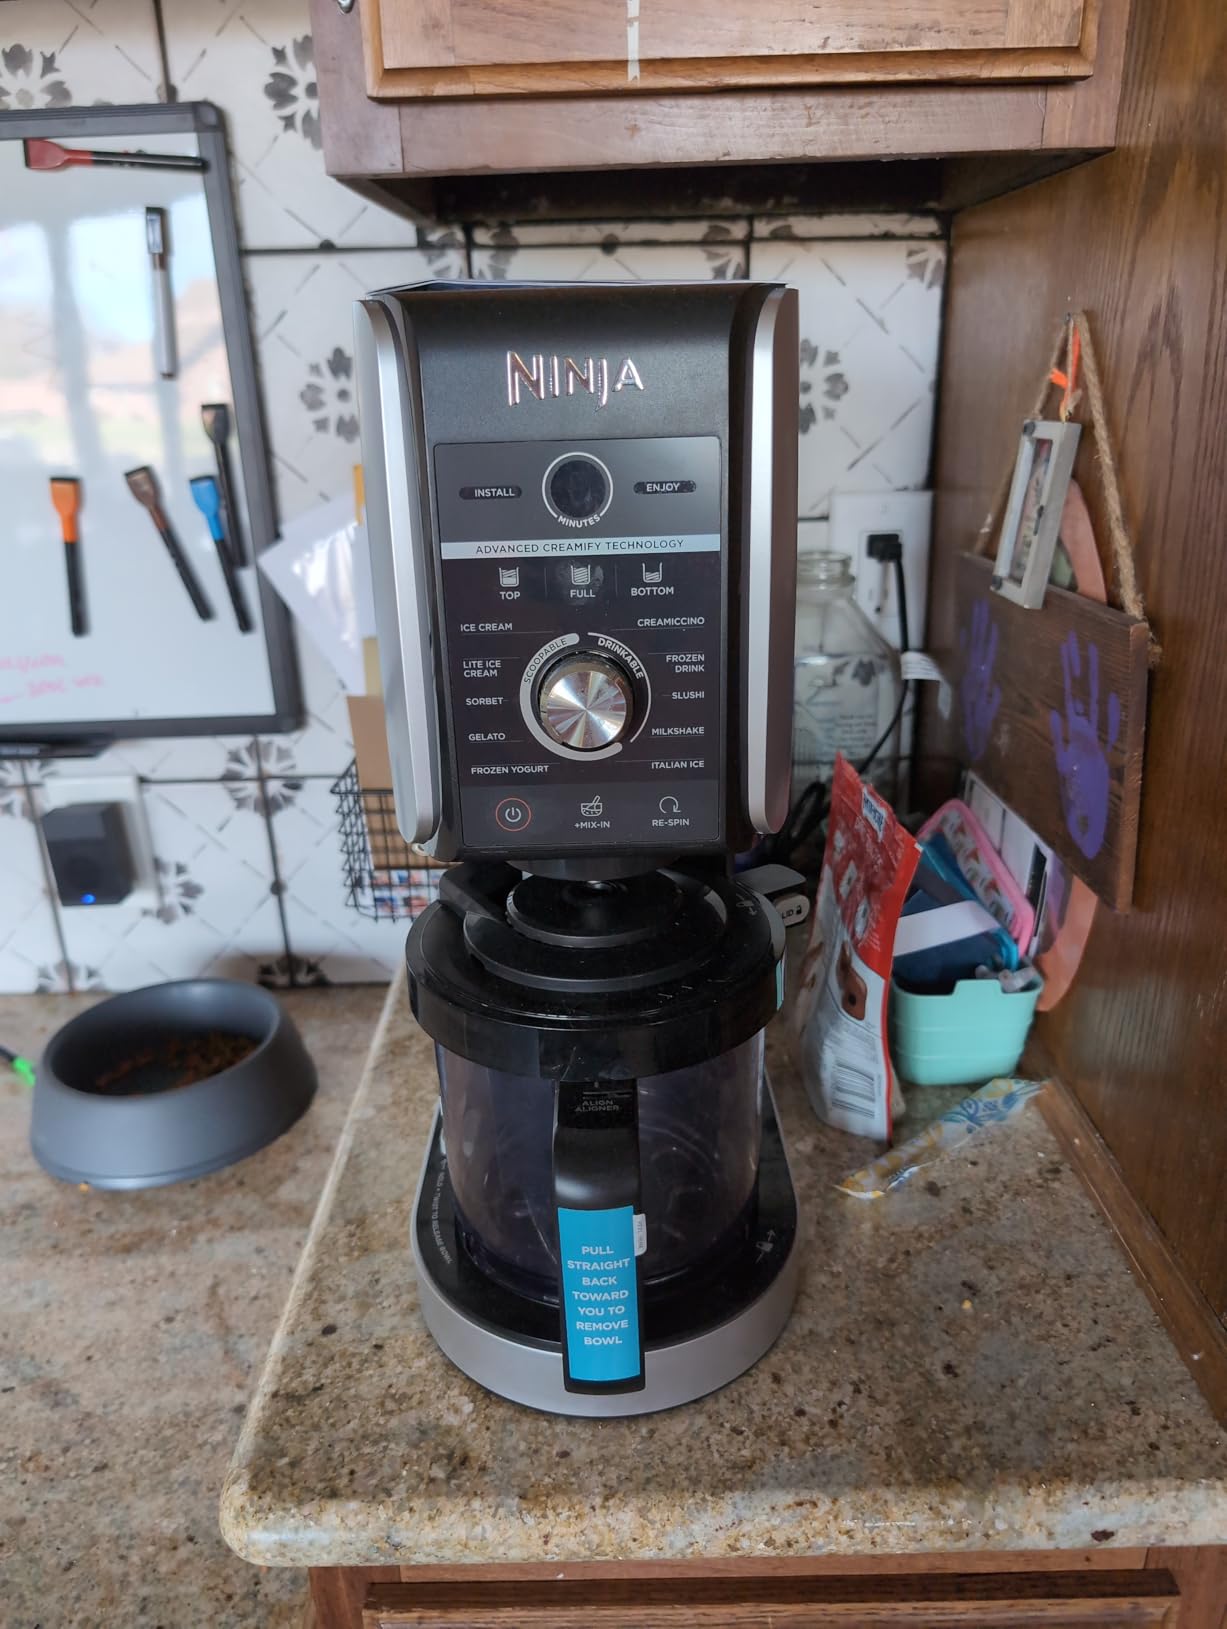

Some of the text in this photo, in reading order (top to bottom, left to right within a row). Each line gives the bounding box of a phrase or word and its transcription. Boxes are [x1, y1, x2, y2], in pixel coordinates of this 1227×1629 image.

[506, 351, 645, 412] NINJA
[646, 482, 681, 492] ENJOY
[474, 488, 515, 498] INSTALL
[557, 514, 601, 528] MINUTES
[476, 538, 685, 554] ADVANCED CREAMIFY TECHNOLOGY
[499, 591, 521, 600] TOP
[570, 588, 595, 598] FULL
[631, 586, 674, 596] BOTTOM
[637, 616, 705, 627] CREAMICCINO
[460, 622, 513, 632] ICE CREAM
[523, 637, 568, 684] SCOOPABLE
[597, 637, 645, 680] DRINKABLE
[666, 654, 705, 663] FROZEN
[463, 659, 502, 669] LITE ICE
[675, 664, 705, 673] DRINK
[463, 669, 498, 678] CREAM
[672, 691, 705, 700] SLUSHI
[465, 697, 504, 706] SORBET
[651, 726, 705, 736] MILKSHAKE
[468, 732, 506, 741] GELATO
[651, 760, 705, 769] ITALIAN ICE
[471, 765, 550, 775] FROZEN YOGURT
[574, 820, 610, 829] +MIX-IN
[652, 818, 690, 827] RE-SPIN
[582, 1246, 614, 1255] PULL
[567, 1257, 631, 1271] STRAIGHT
[582, 1276, 617, 1286] BACK
[571, 1289, 629, 1301] TOWARD
[578, 1305, 625, 1316] YOU TO
[576, 1319, 629, 1331] REMOVE
[583, 1335, 623, 1345] BOWL
